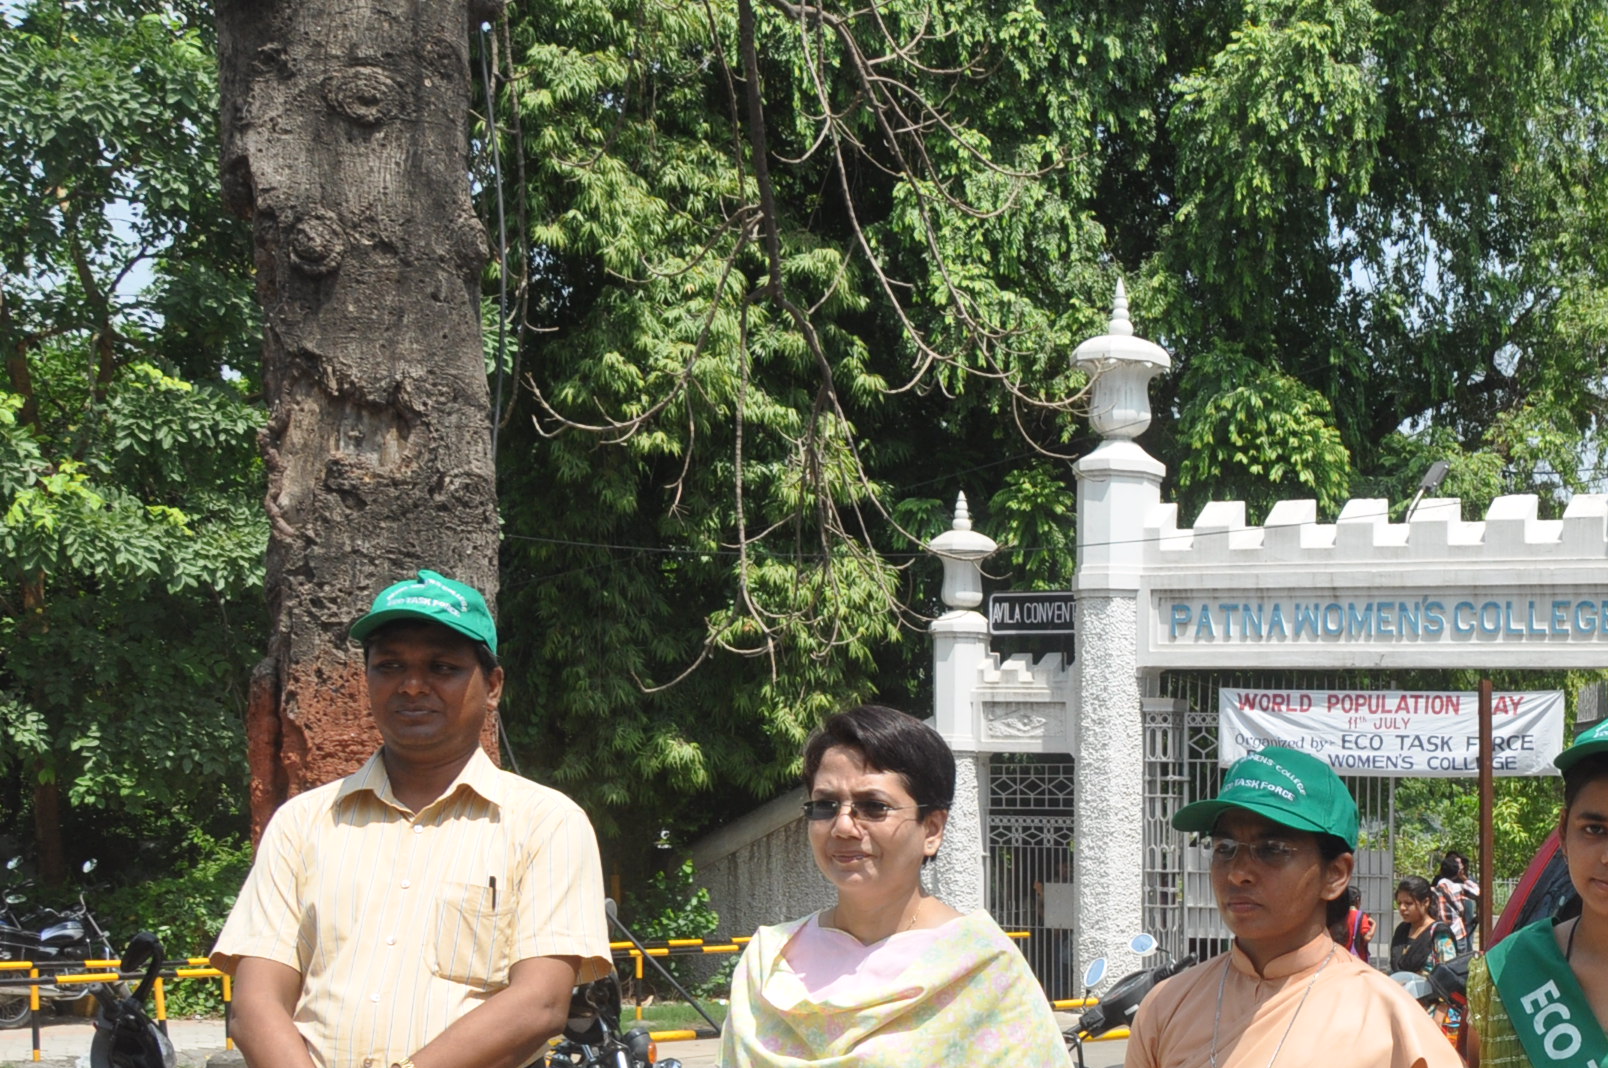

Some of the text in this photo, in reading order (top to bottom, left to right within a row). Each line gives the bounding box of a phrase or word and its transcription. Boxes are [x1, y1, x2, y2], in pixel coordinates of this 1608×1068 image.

[992, 602, 1077, 624] AVILA CONVENT
[1170, 603, 1288, 638] PATNA
[1294, 595, 1446, 637] WOMEN'S
[1237, 693, 1524, 715] WORLD POPULATION AY
[1373, 717, 1410, 730] JULY
[1235, 733, 1305, 749] Organized
[1342, 734, 1383, 750] ECO
[1395, 735, 1453, 752] TASK
[1466, 735, 1534, 751] FRCE
[1328, 754, 1517, 770] WOMEN'S COLLGE
[1235, 778, 1260, 790] TASK
[1260, 780, 1296, 802] FORCE
[1276, 764, 1306, 797] COLLEGE
[1520, 979, 1582, 1060] ECO
